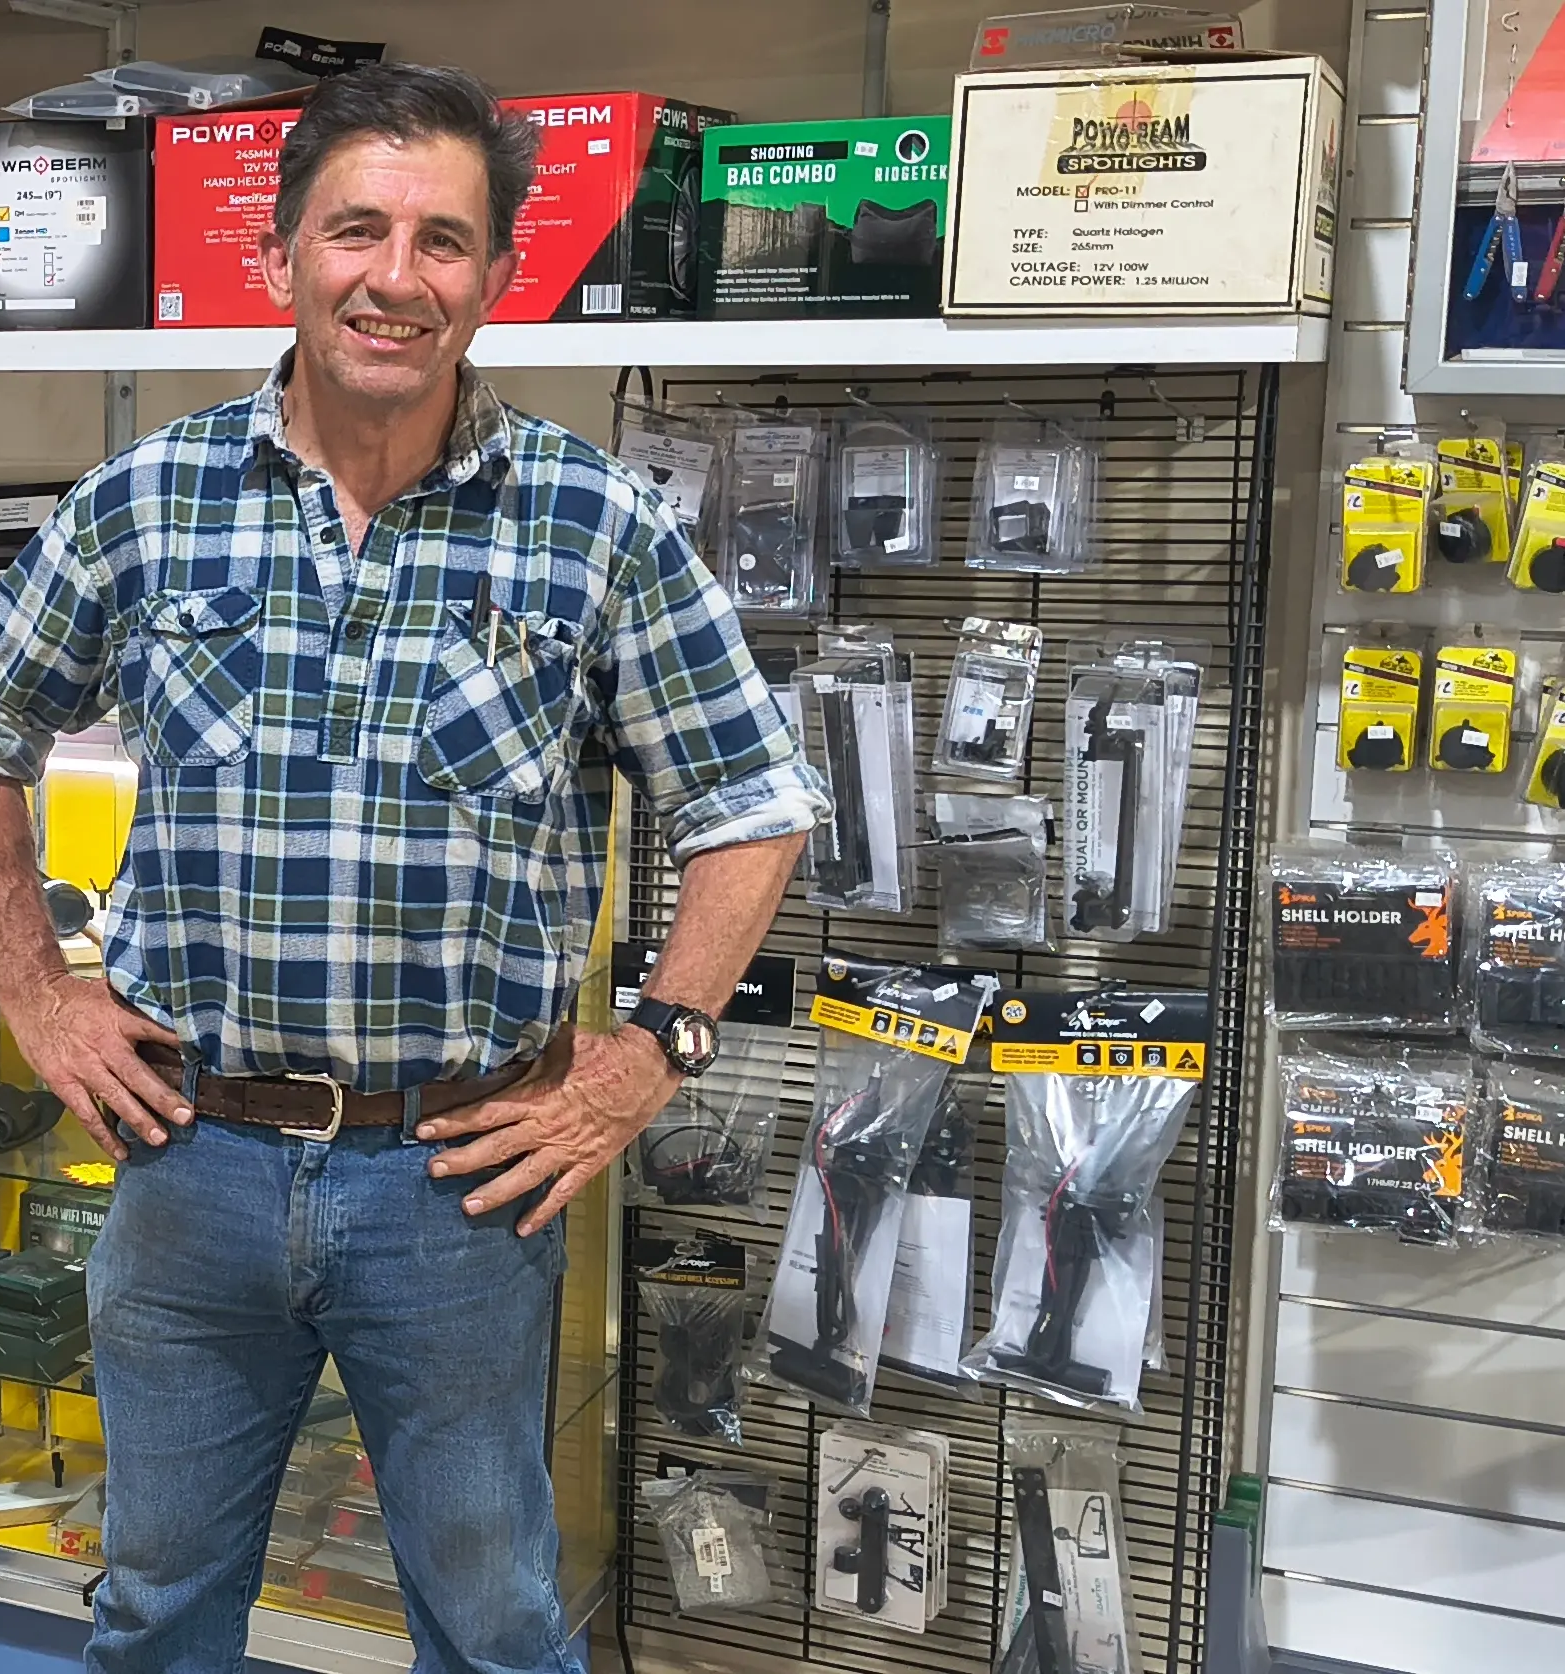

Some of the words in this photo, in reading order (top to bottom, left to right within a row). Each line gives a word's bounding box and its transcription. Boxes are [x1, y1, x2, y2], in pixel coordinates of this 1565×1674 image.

[653, 106, 688, 131] POWA
[172, 123, 255, 144] POWA
[235, 150, 273, 160] 245MM
[750, 145, 814, 161] SHOOTING
[51, 157, 107, 171] BEAM
[243, 162, 261, 173] 12V
[262, 161, 279, 172] 70
[536, 163, 577, 175] TLIGHT
[1067, 154, 1197, 171] SPOTLIGHTS
[51, 174, 107, 183] SPOTLIGHTS
[727, 166, 763, 186] BAG
[769, 164, 836, 185] COMBO
[874, 165, 948, 182] RIDGETEK
[203, 177, 236, 188] HAND
[237, 176, 268, 187] HELD
[1016, 185, 1070, 197] MODEL:
[1094, 185, 1137, 196] PRO-11
[228, 192, 277, 205] Specificat
[1093, 199, 1118, 211] With
[1120, 200, 1167, 210] Dimmer
[1170, 198, 1214, 209] Control
[1012, 228, 1048, 240] TYPE:
[1072, 227, 1111, 238] Quartz
[1113, 225, 1164, 239] Halogen
[1012, 242, 1043, 253] SIZE:
[1071, 241, 1114, 252] 265mm
[1010, 261, 1081, 273] VOLTAGE:
[1093, 261, 1115, 272] 12V
[1118, 261, 1149, 272] 100W
[1009, 275, 1067, 287] CANDLE
[1069, 275, 1126, 286] POWER:
[1135, 275, 1157, 286] 1.25
[1160, 275, 1209, 286] MILLION
[1076, 805, 1089, 832] QR
[1281, 908, 1329, 924] SHELL
[1334, 910, 1402, 925] HOLDER
[1516, 1110, 1543, 1123] SPIKA
[1504, 1125, 1554, 1146] SHELL
[1294, 1138, 1343, 1156] SHELL
[1349, 1142, 1417, 1161] HOLDER
[30, 1202, 58, 1220] SOLAR
